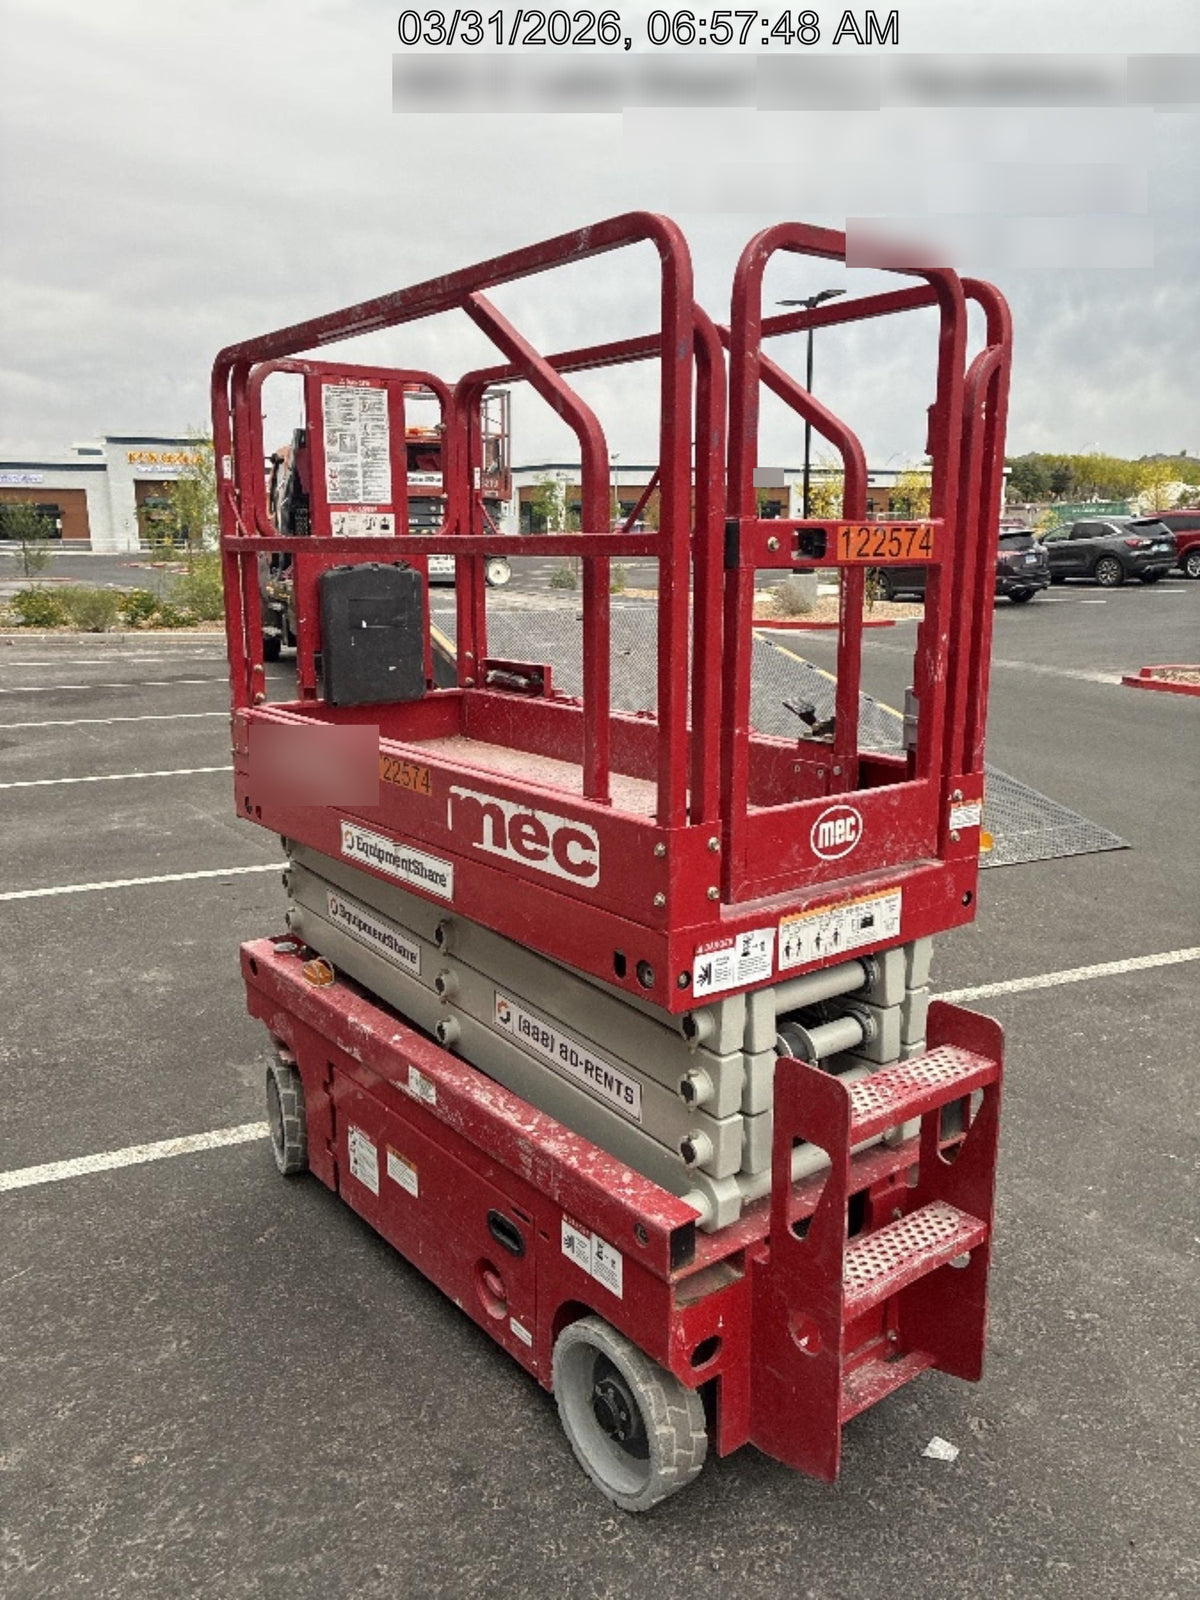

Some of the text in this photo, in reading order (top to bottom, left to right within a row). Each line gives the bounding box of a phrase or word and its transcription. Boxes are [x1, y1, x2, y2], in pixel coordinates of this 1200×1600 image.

[841, 526, 932, 559] 122574
[380, 755, 430, 794] 22574
[355, 834, 447, 888] EquipmentShare
[339, 903, 419, 965] EquipmentShare
[518, 1014, 634, 1105] (888) 80-RENTS
